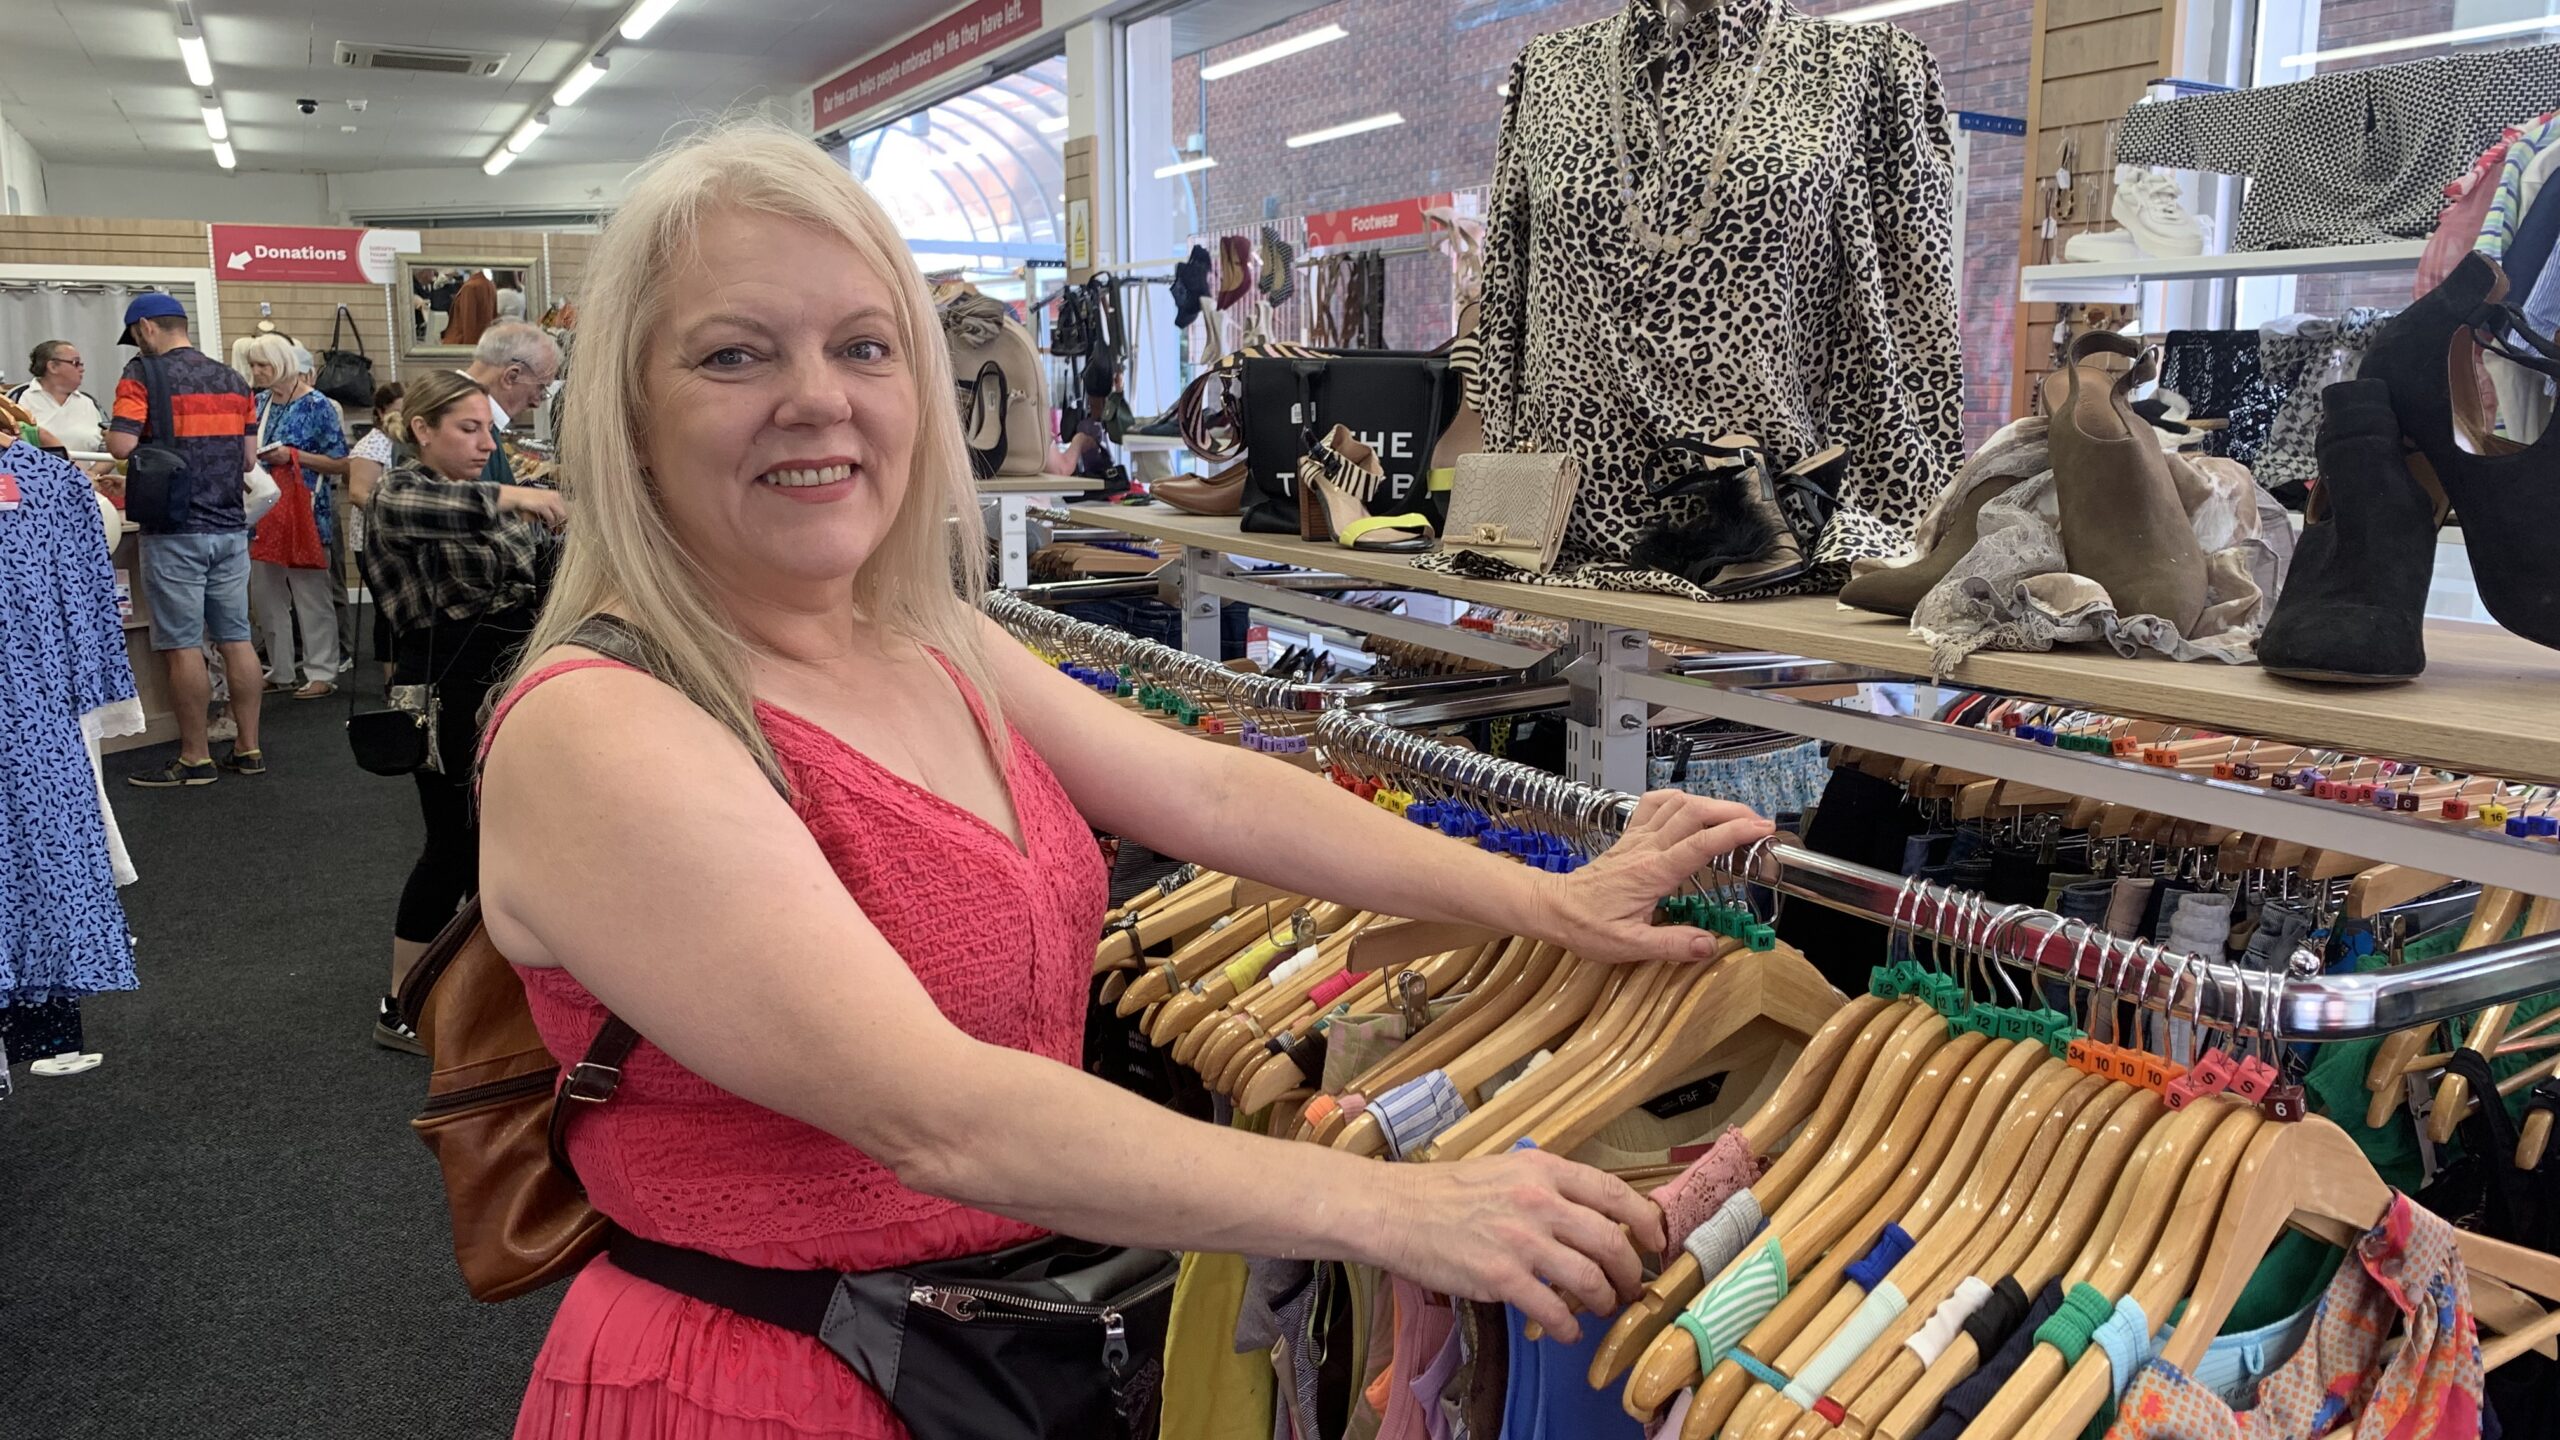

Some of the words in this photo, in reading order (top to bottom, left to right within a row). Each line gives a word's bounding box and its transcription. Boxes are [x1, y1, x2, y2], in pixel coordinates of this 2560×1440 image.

[823, 96, 833, 113] Our
[834, 90, 845, 109] free
[846, 84, 859, 103] care
[859, 75, 876, 97] helps
[877, 61, 900, 92] people
[901, 47, 932, 76] embrace
[932, 39, 945, 62] the
[946, 30, 960, 54] life
[961, 23, 980, 47] they
[981, 14, 1004, 37] have
[1004, 0, 1025, 26] left.
[1351, 213, 1399, 232] Footwear
[254, 244, 347, 261] Donations
[1351, 431, 1413, 458] HE
[2115, 742, 2124, 751] 10
[2127, 740, 2136, 749] 10
[2146, 753, 2153, 762] 10
[2156, 755, 2163, 763] 10
[2169, 754, 2177, 764] 10
[2217, 766, 2226, 775] 10
[2235, 766, 2246, 776] 30
[2250, 769, 2259, 778] 30
[2273, 776, 2286, 786] 30
[2302, 774, 2309, 783] 8
[2319, 785, 2326, 794] S
[2340, 790, 2347, 799] S
[1377, 793, 1386, 804] 16
[2377, 795, 2391, 804] XS
[2403, 799, 2411, 808] 6
[2490, 812, 2503, 822] 16
[1758, 936, 1770, 947] M
[1878, 983, 1893, 995] 12
[1921, 983, 1931, 999] 12
[1938, 997, 1946, 1009] 12
[1976, 1014, 1989, 1030] 12
[2006, 1019, 2021, 1033] 12
[1952, 1023, 1965, 1035] M
[2031, 1021, 2044, 1036] 12
[2054, 1038, 2067, 1054] 12
[2069, 1046, 2085, 1064] 34
[2095, 1056, 2110, 1072] 10
[2120, 1061, 2135, 1078] 10
[2147, 1069, 2162, 1086] 10
[2201, 1071, 2216, 1085] S
[2240, 1080, 2255, 1094] S
[1678, 1089, 1699, 1106] F&F
[2170, 1092, 2181, 1108] S
[2275, 1101, 2288, 1117] 6
